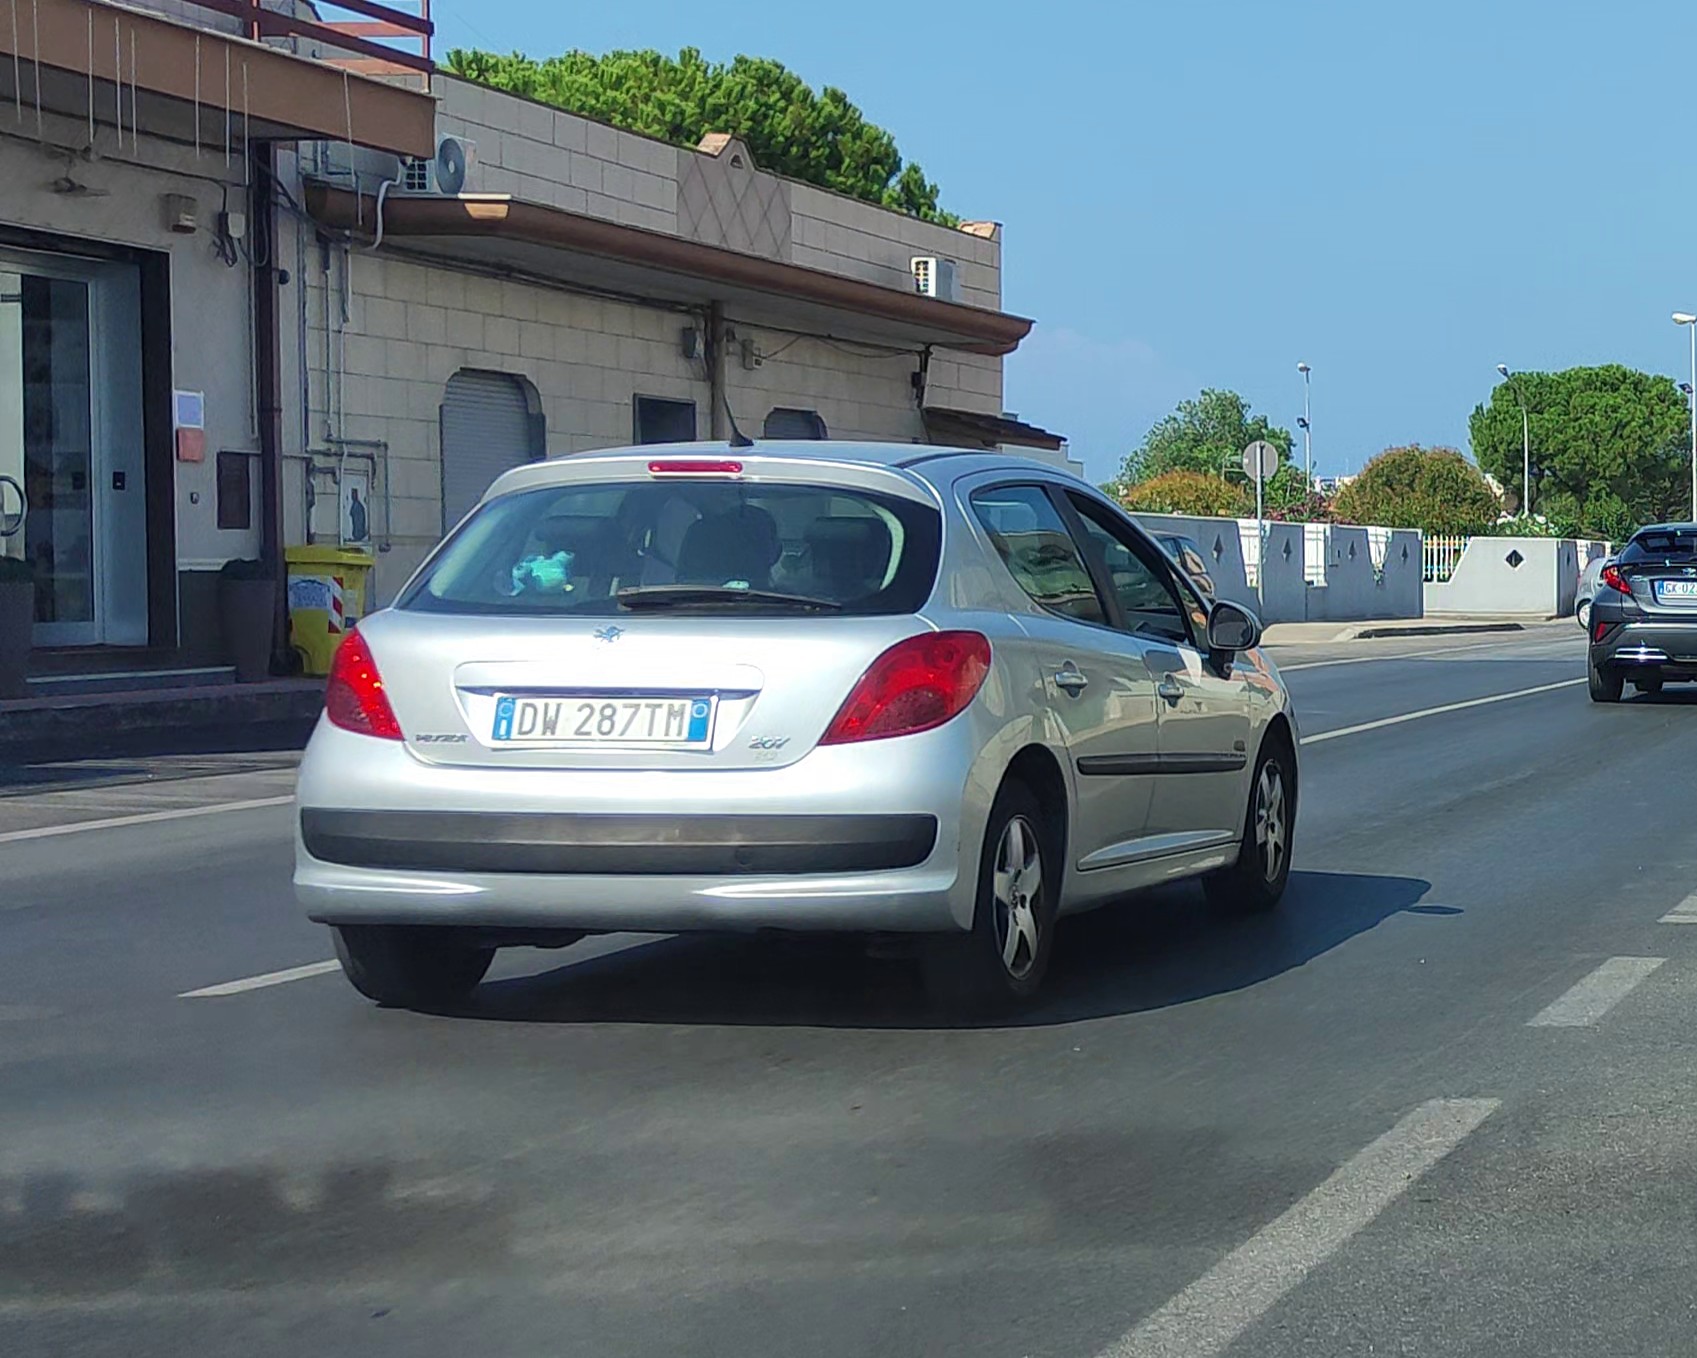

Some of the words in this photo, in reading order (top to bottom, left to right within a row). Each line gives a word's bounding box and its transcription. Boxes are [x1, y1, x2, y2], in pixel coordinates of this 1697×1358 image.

[1681, 583, 1697, 594] 02
[517, 702, 562, 736] DW
[574, 702, 687, 737] 287TM
